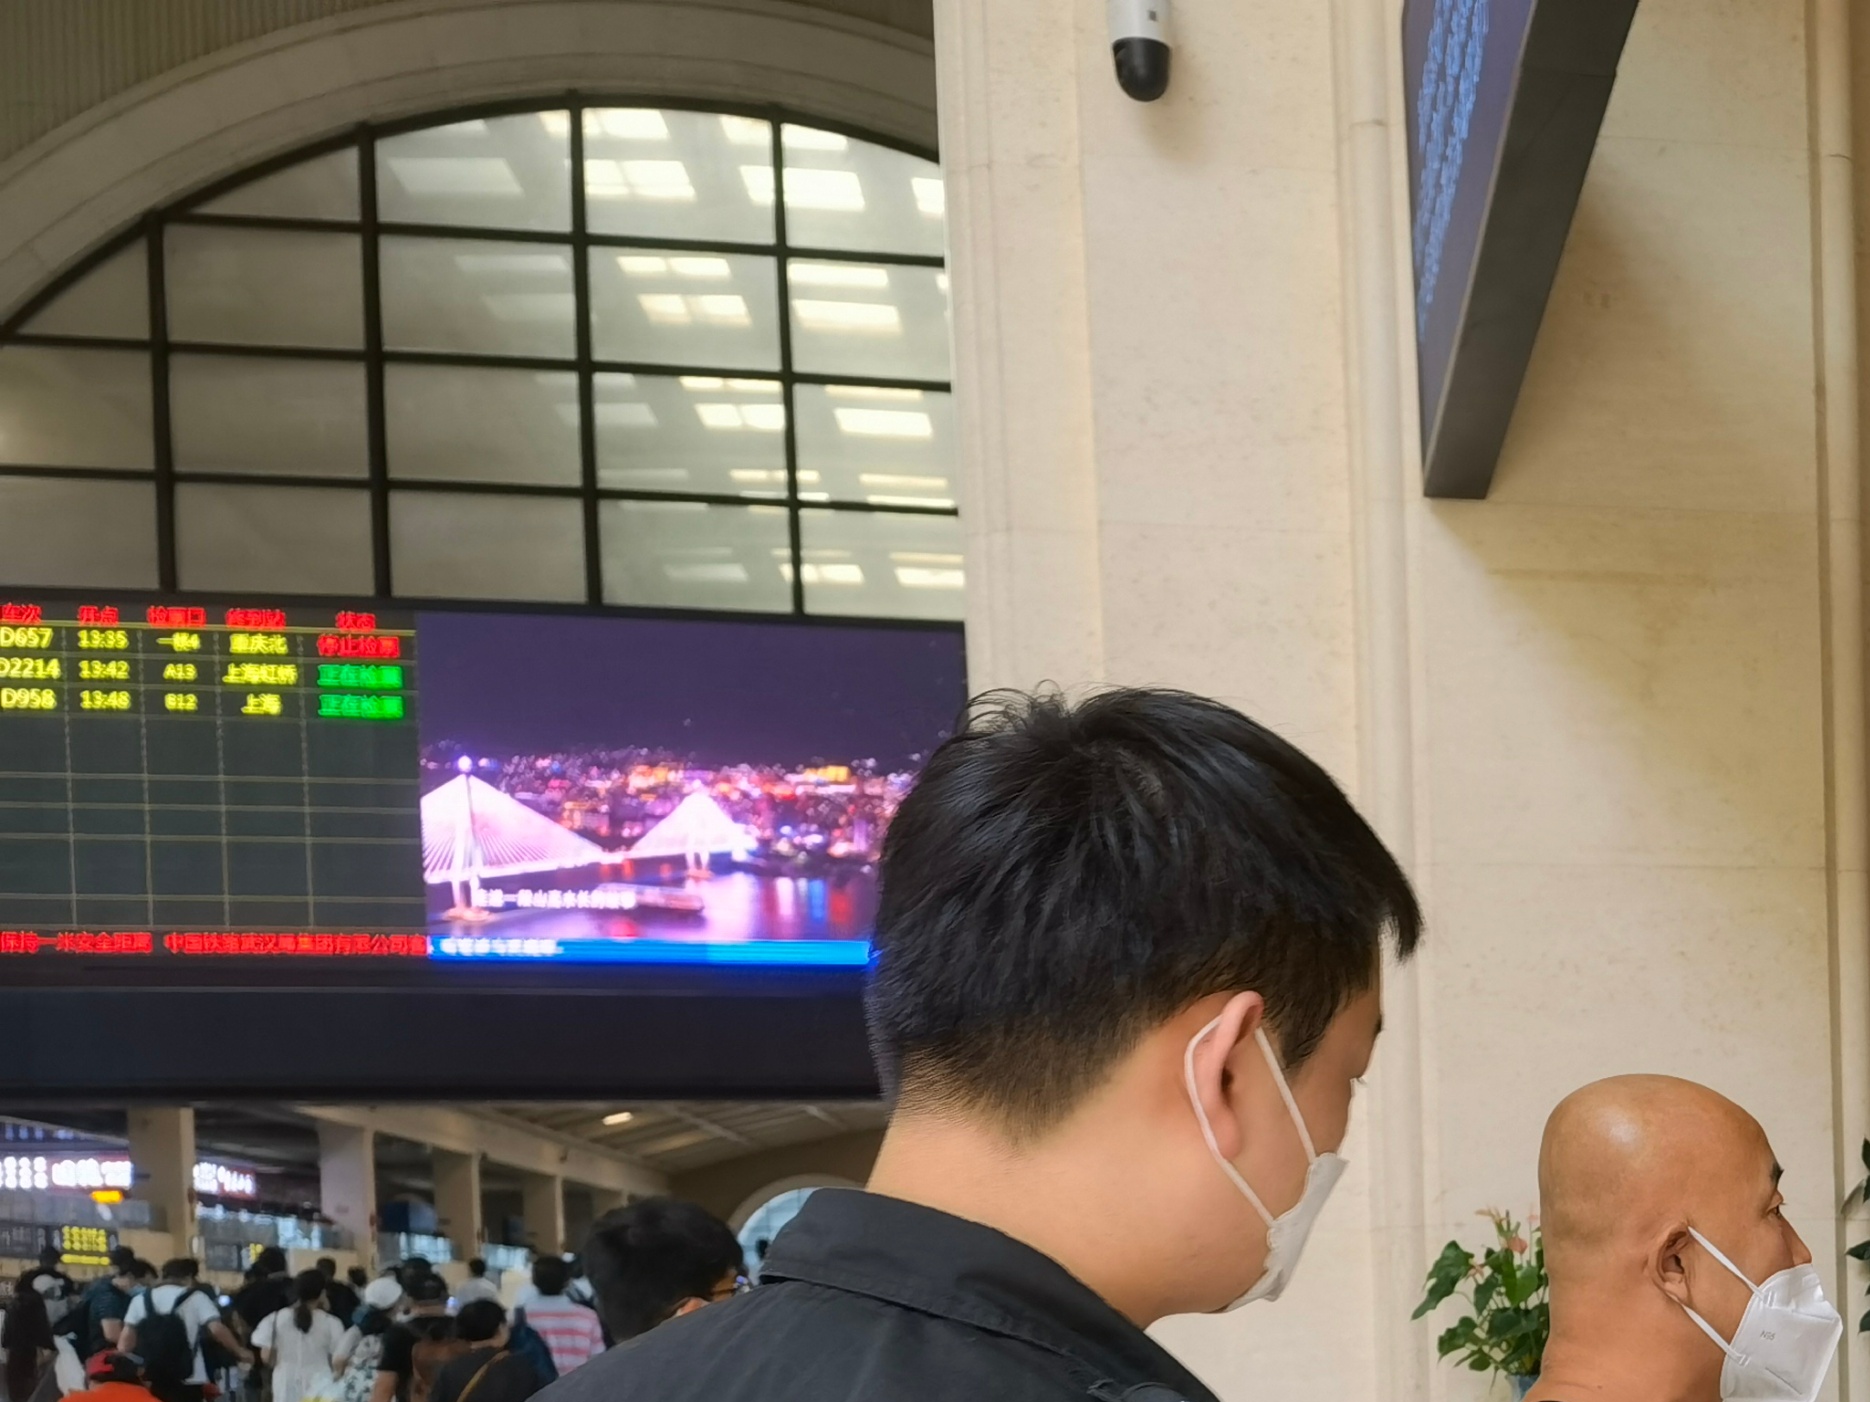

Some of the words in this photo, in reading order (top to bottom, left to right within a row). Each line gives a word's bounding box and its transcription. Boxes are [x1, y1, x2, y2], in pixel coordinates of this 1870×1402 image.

[78, 630, 129, 649] 13:35
[229, 634, 288, 654] 重庆北
[317, 634, 400, 658] 停止检票
[79, 660, 130, 679] 13:42
[222, 663, 298, 684] 上海虹桥
[317, 664, 402, 689] 正在检票
[80, 690, 131, 709] 13:48
[241, 693, 283, 715] 上海
[317, 694, 403, 719] 正在检票
